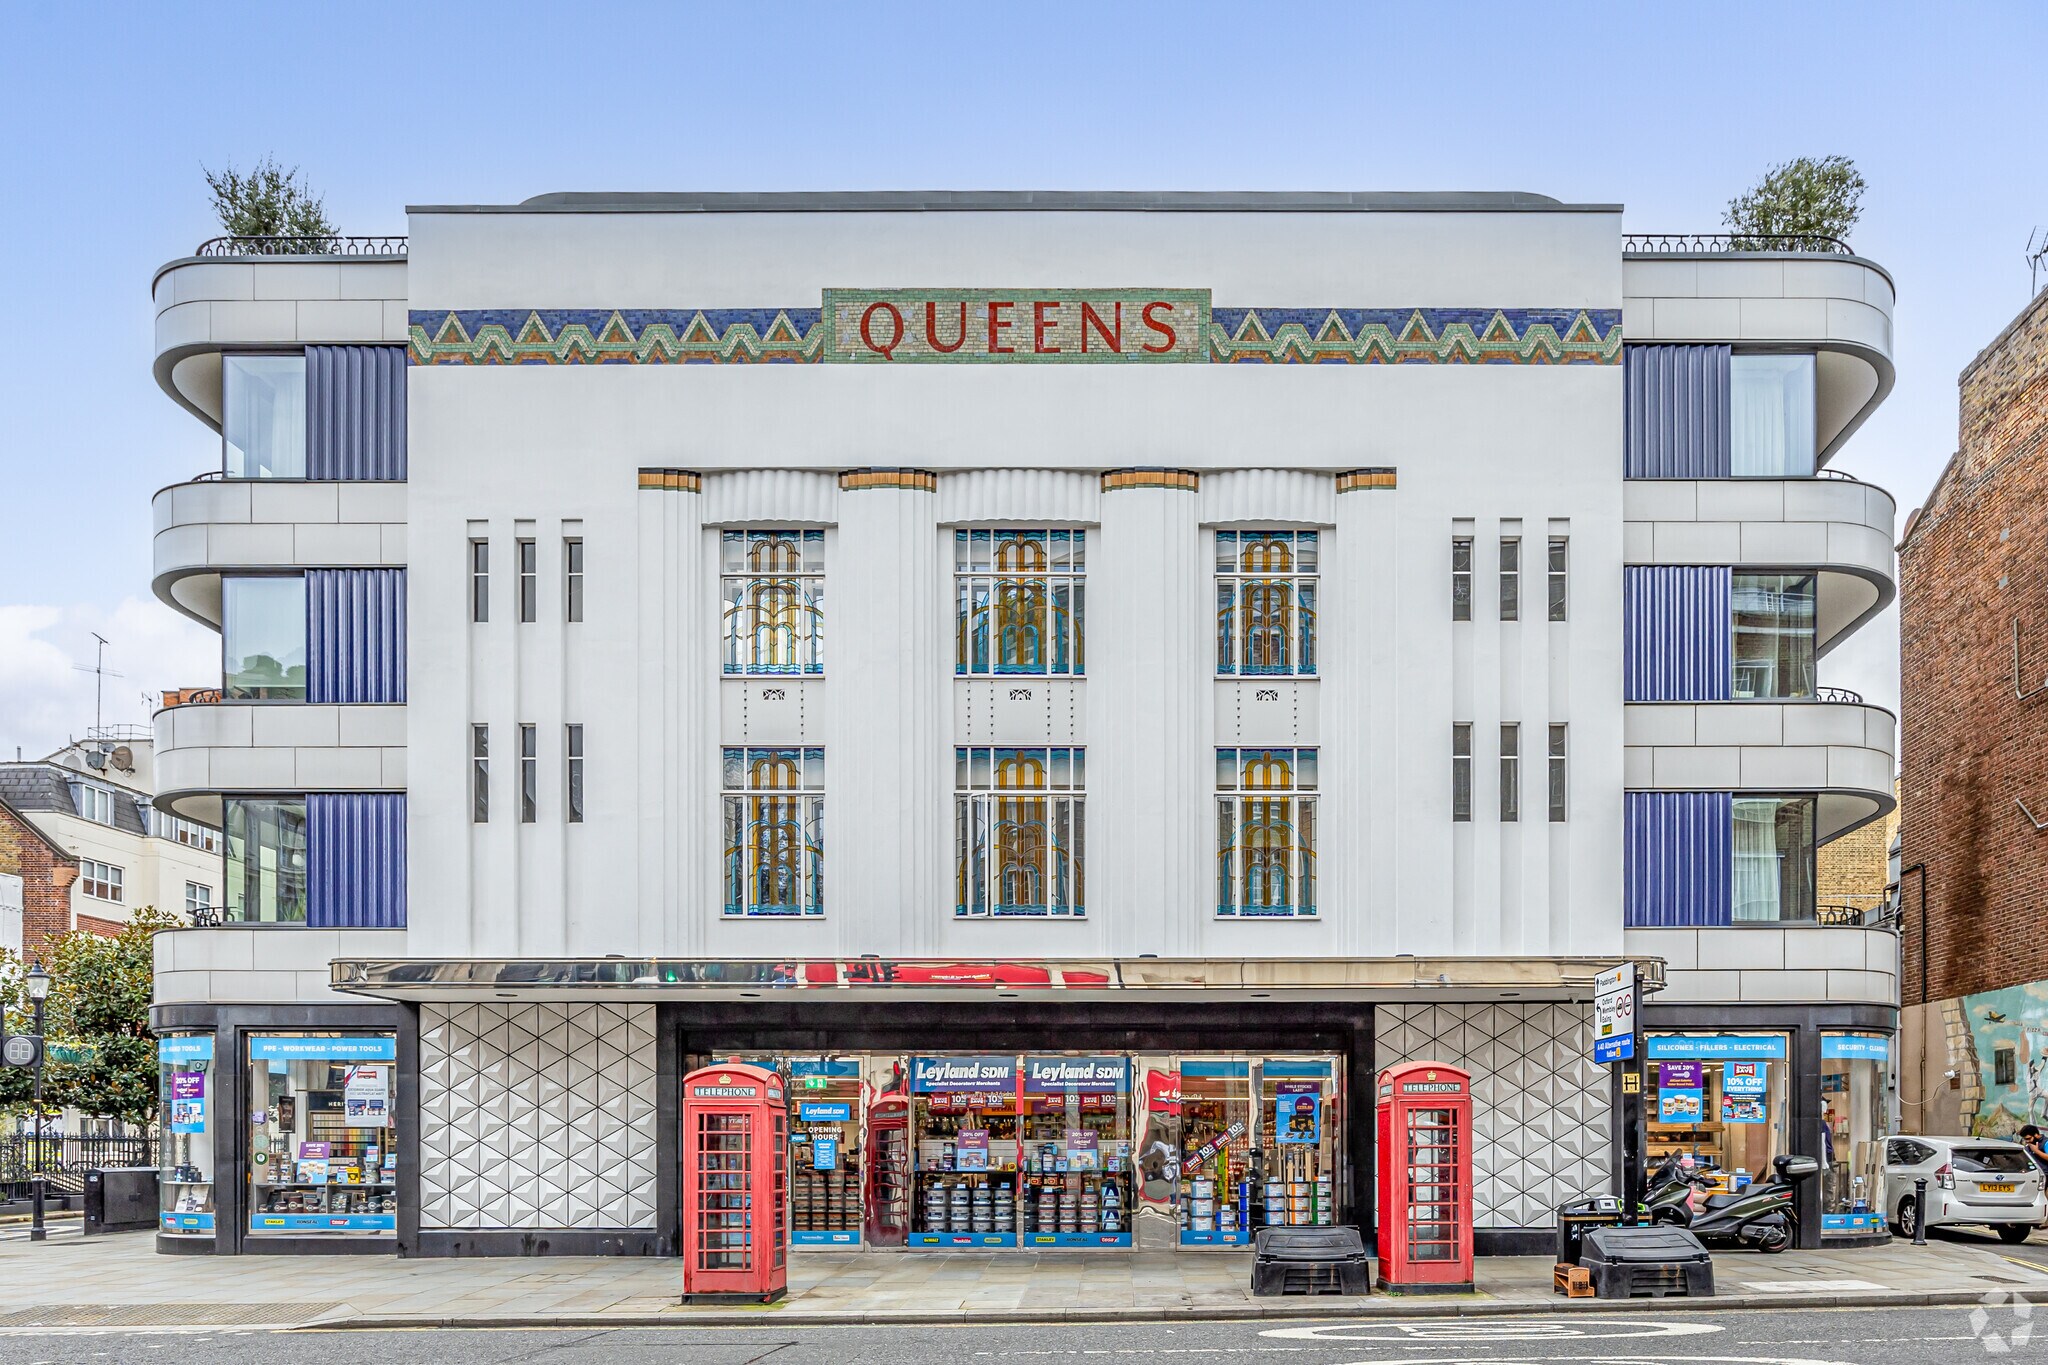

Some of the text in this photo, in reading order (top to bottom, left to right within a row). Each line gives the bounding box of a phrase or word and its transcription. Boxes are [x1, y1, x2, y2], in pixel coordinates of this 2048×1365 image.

[860, 301, 1175, 360] QUEENS
[1602, 997, 1612, 1006] Oxford
[1602, 1016, 1612, 1024] Ealing
[916, 1062, 1009, 1081] Leyland SDM
[1032, 1062, 1124, 1081] Leyland SDM
[1624, 1076, 1638, 1090] H
[1727, 1078, 1763, 1086] 10% OFF
[698, 1088, 752, 1096] TELEPHONE
[1406, 1084, 1458, 1092] TELEPHONE
[806, 1107, 832, 1116] Leyland
